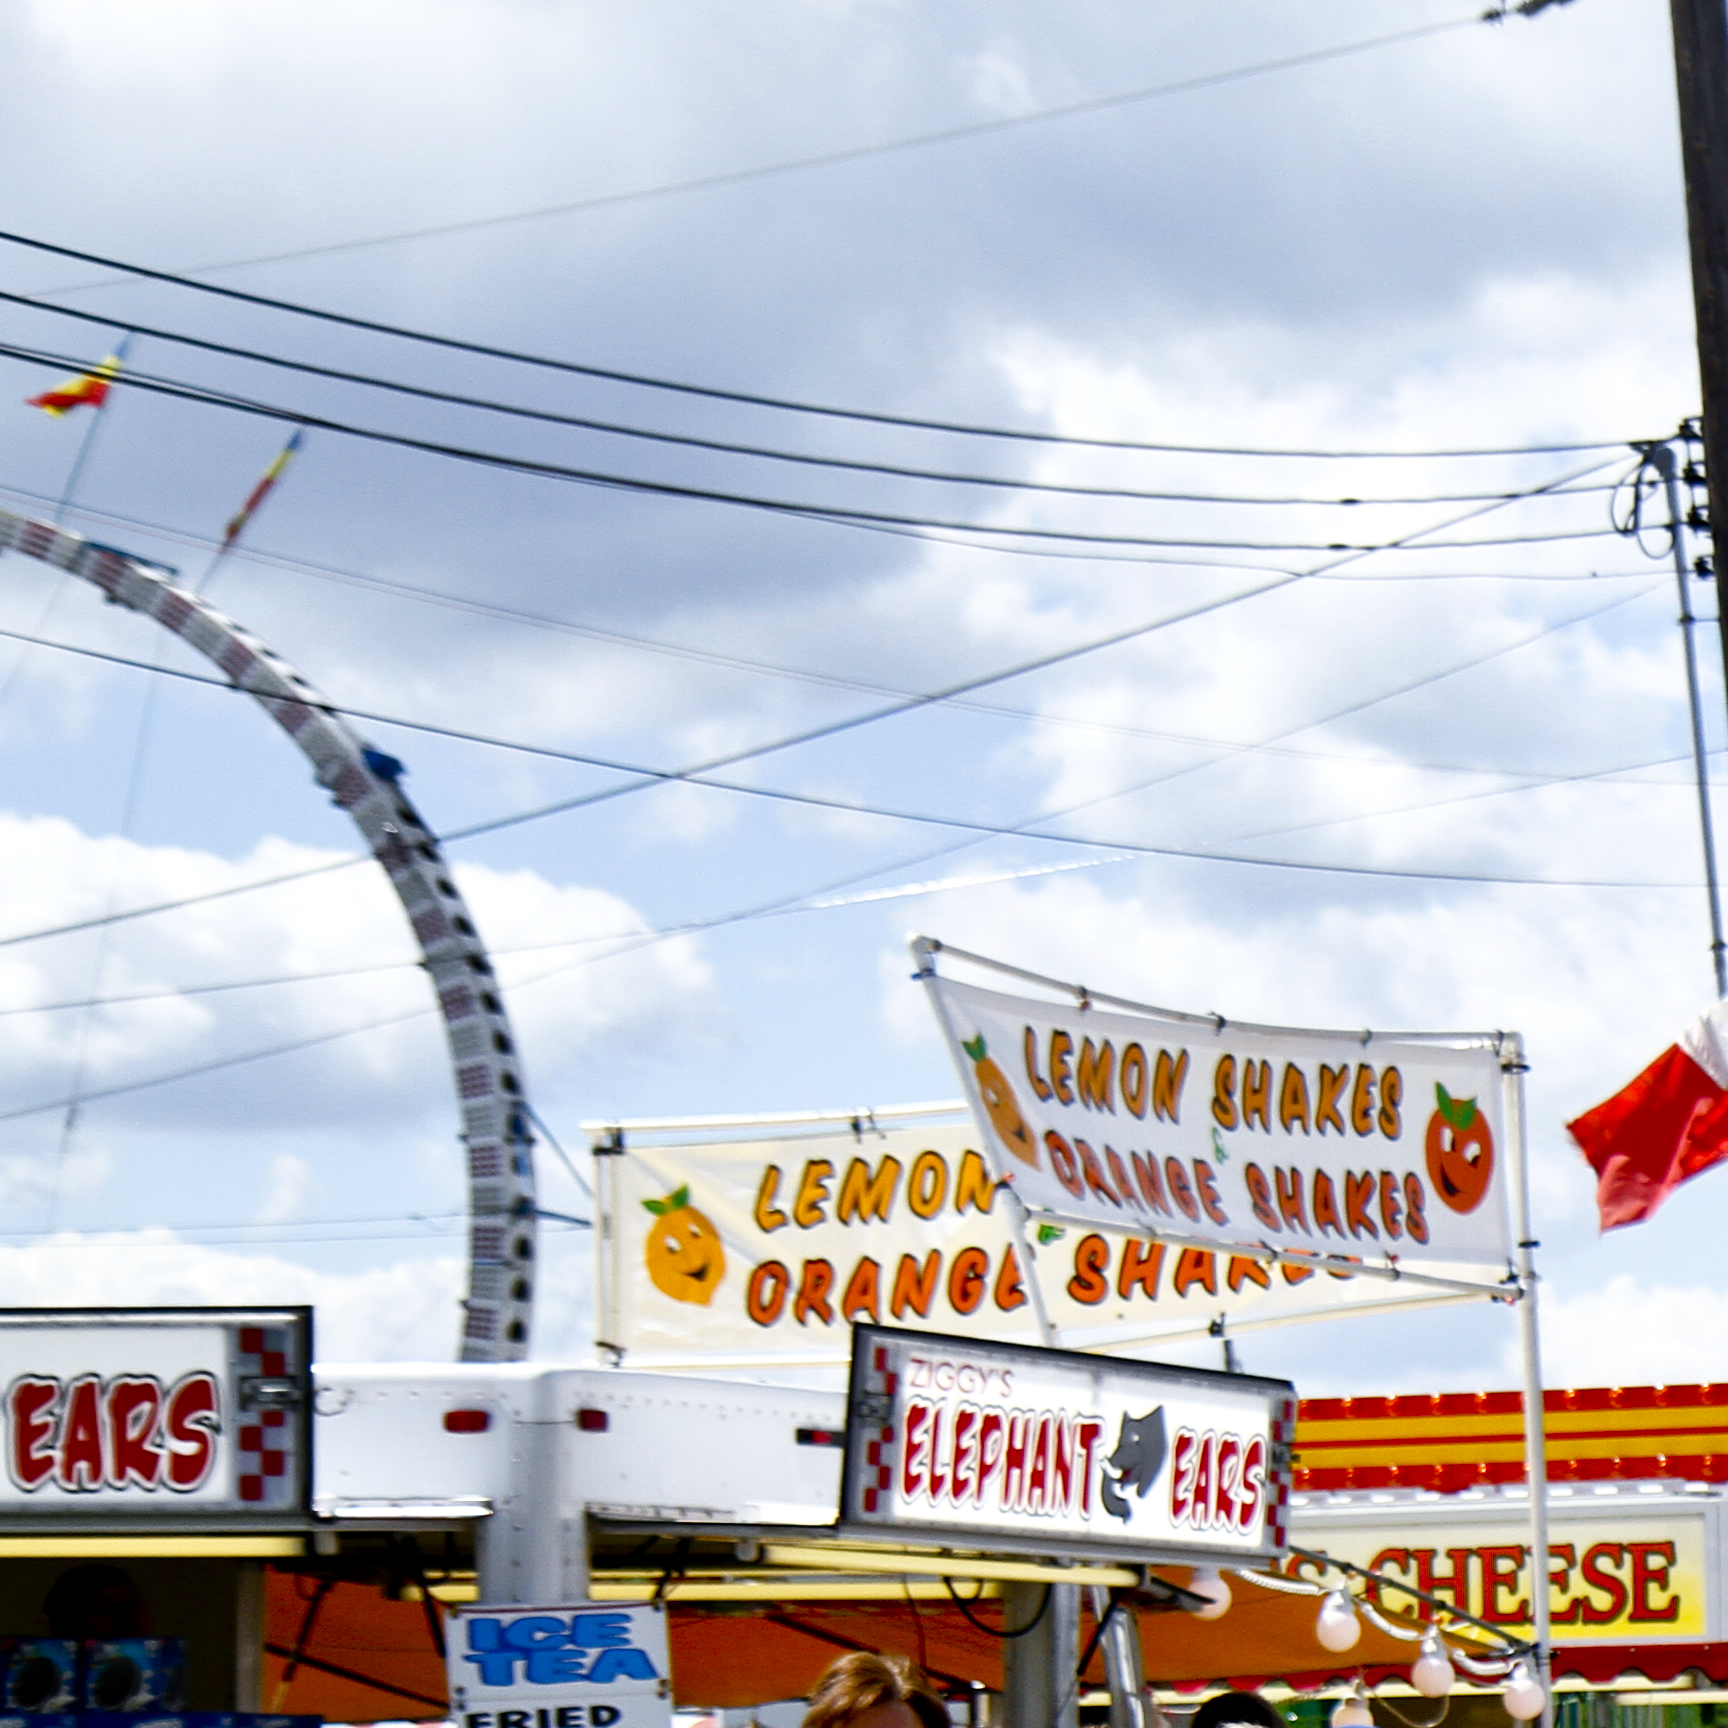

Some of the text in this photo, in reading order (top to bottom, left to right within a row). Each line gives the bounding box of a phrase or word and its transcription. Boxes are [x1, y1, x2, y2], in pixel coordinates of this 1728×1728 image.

[1024, 1025, 1402, 1140] LEMON SHAKES
[755, 1150, 996, 1233] LEMON
[1044, 1128, 1430, 1245] ORANGE SHAKES
[747, 1233, 1361, 1327] ORANGE SHAK
[909, 1357, 1015, 1398] ZIGGY'S
[5, 1370, 222, 1493] EARS
[900, 1394, 1266, 1536] ELEPHANT EARS
[1366, 1541, 1680, 1624] CHEESE
[463, 1647, 659, 1687] TEA
[466, 1613, 633, 1652] ICE
